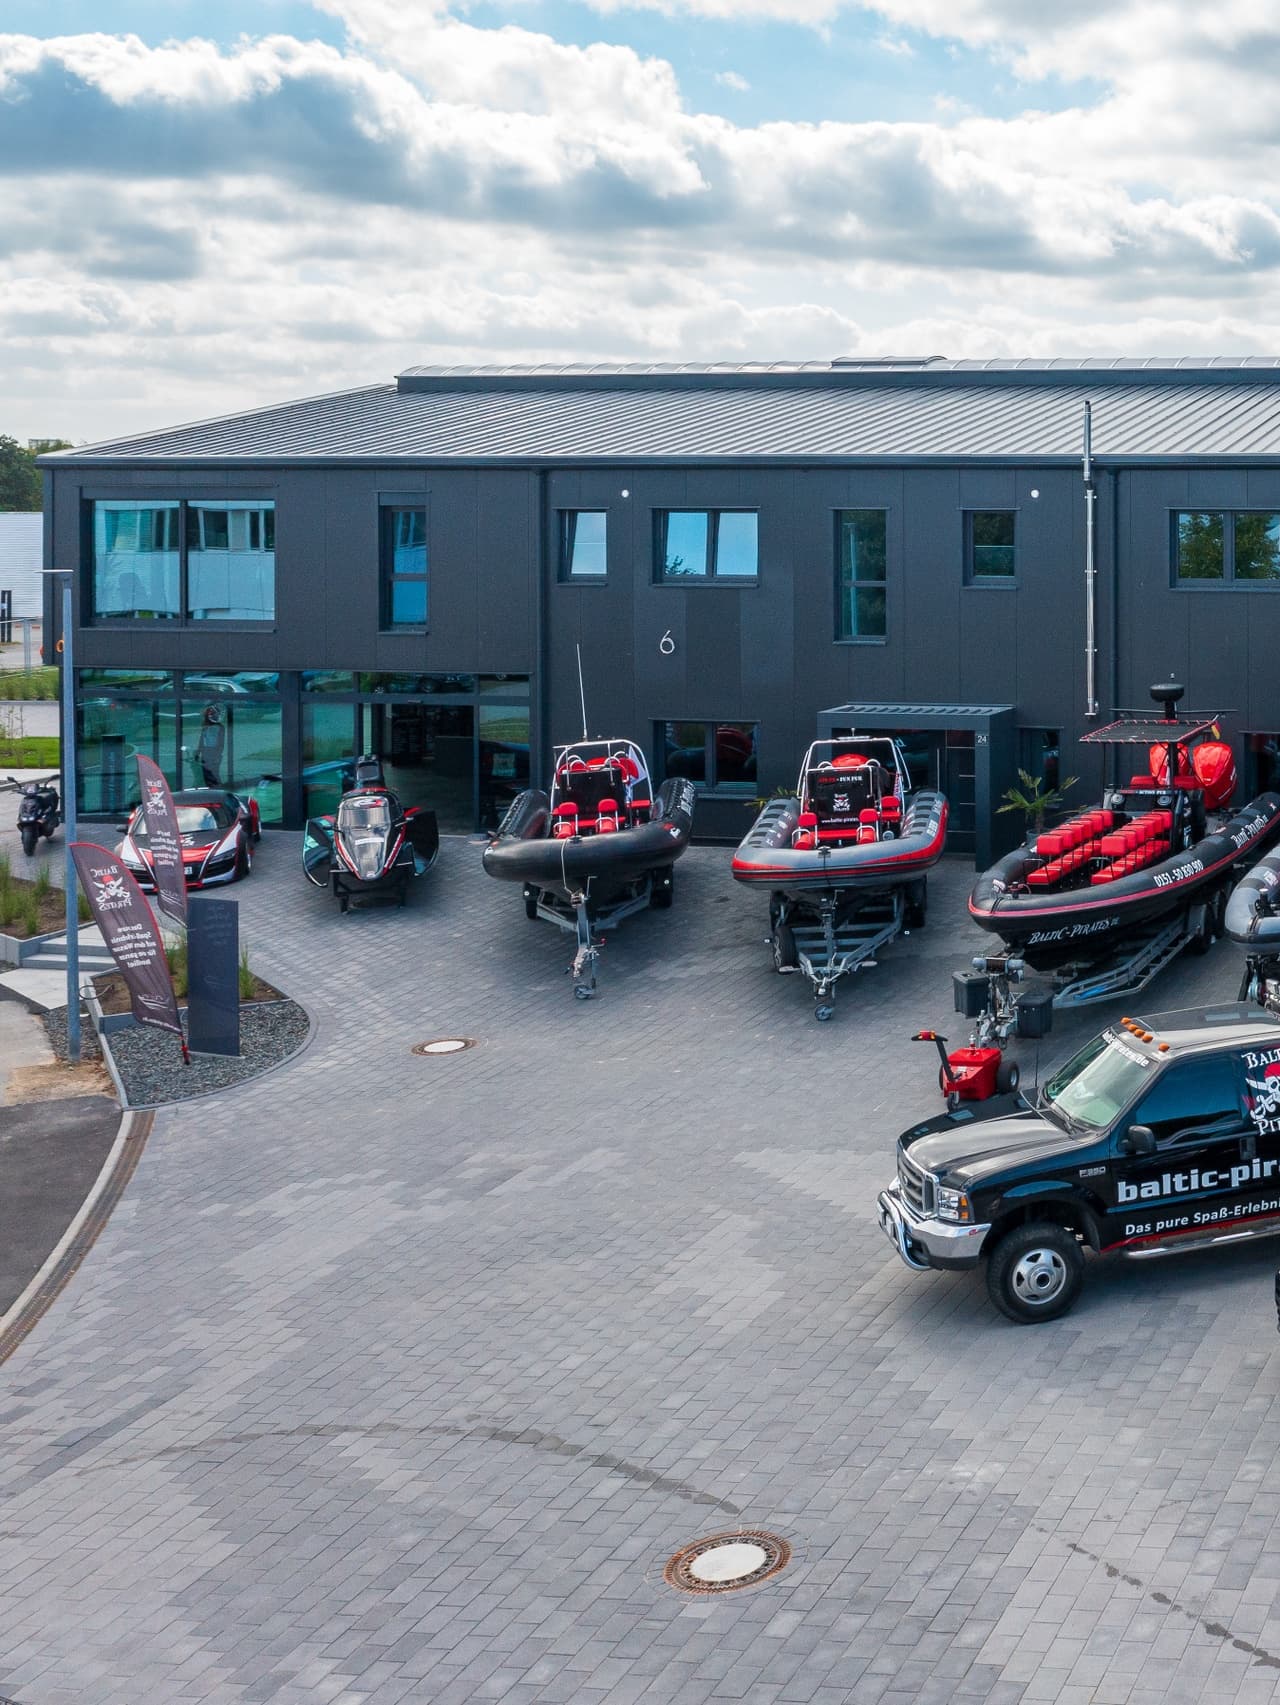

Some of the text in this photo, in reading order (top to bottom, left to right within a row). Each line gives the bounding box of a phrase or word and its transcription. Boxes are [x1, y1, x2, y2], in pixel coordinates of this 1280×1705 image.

[977, 735, 987, 744] 24
[1125, 1222, 1151, 1236] Das
[1156, 1215, 1189, 1232] pure
